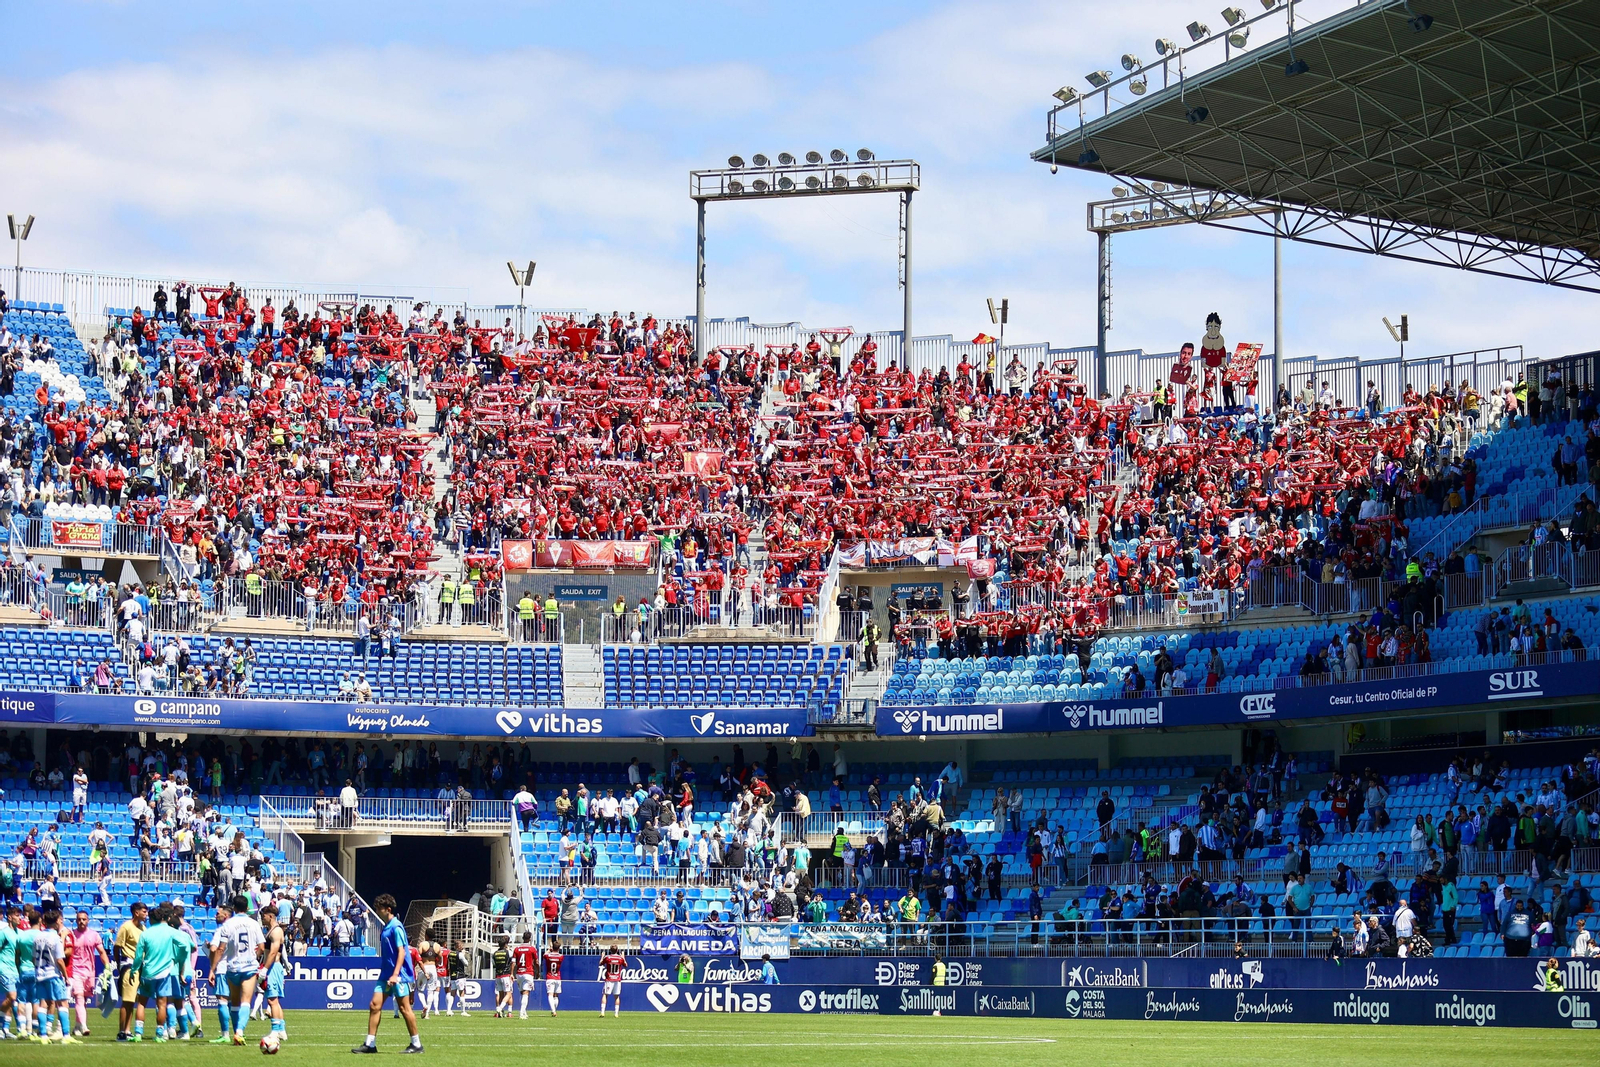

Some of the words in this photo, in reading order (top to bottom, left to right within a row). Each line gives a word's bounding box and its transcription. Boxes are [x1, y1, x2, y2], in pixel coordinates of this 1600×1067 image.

[1489, 670, 1540, 692] SUR
[1330, 695, 1354, 705] Cesur,
[1355, 694, 1364, 703] tu
[1364, 692, 1390, 702] Centro
[1391, 689, 1415, 700] Oficial
[1416, 688, 1426, 698] de
[1427, 686, 1438, 697] FP
[160, 701, 220, 717] campano
[1088, 702, 1163, 726] hummel
[134, 716, 220, 726] www.hermanoscampano.com
[390, 714, 430, 728] Olmedo
[528, 712, 602, 734] vithas
[714, 720, 790, 736] Sanamar
[922, 708, 1003, 732] hummel
[654, 928, 672, 936] PEÑA
[672, 928, 716, 936] MALAGUISTA
[239, 932, 249, 953] 5
[641, 940, 736, 951] ALAMEDA
[743, 945, 788, 956] ARCHIDONA
[828, 939, 862, 949] TEBA
[520, 953, 526, 966] 4
[898, 962, 920, 970] Diego
[966, 962, 982, 970] Diego
[295, 962, 381, 980] humme
[550, 962, 557, 974] 8
[610, 963, 620, 974] 10
[703, 958, 763, 984] famades
[1084, 966, 1140, 986] CaixaBank
[1533, 960, 1600, 992] SnMig
[1210, 968, 1244, 988] enPie.es
[685, 986, 772, 1012] vithas
[819, 988, 879, 1010] trafilex
[991, 995, 1030, 1010] CaixaBank
[1083, 990, 1105, 1000] COSTA
[1558, 995, 1590, 1018] Olin
